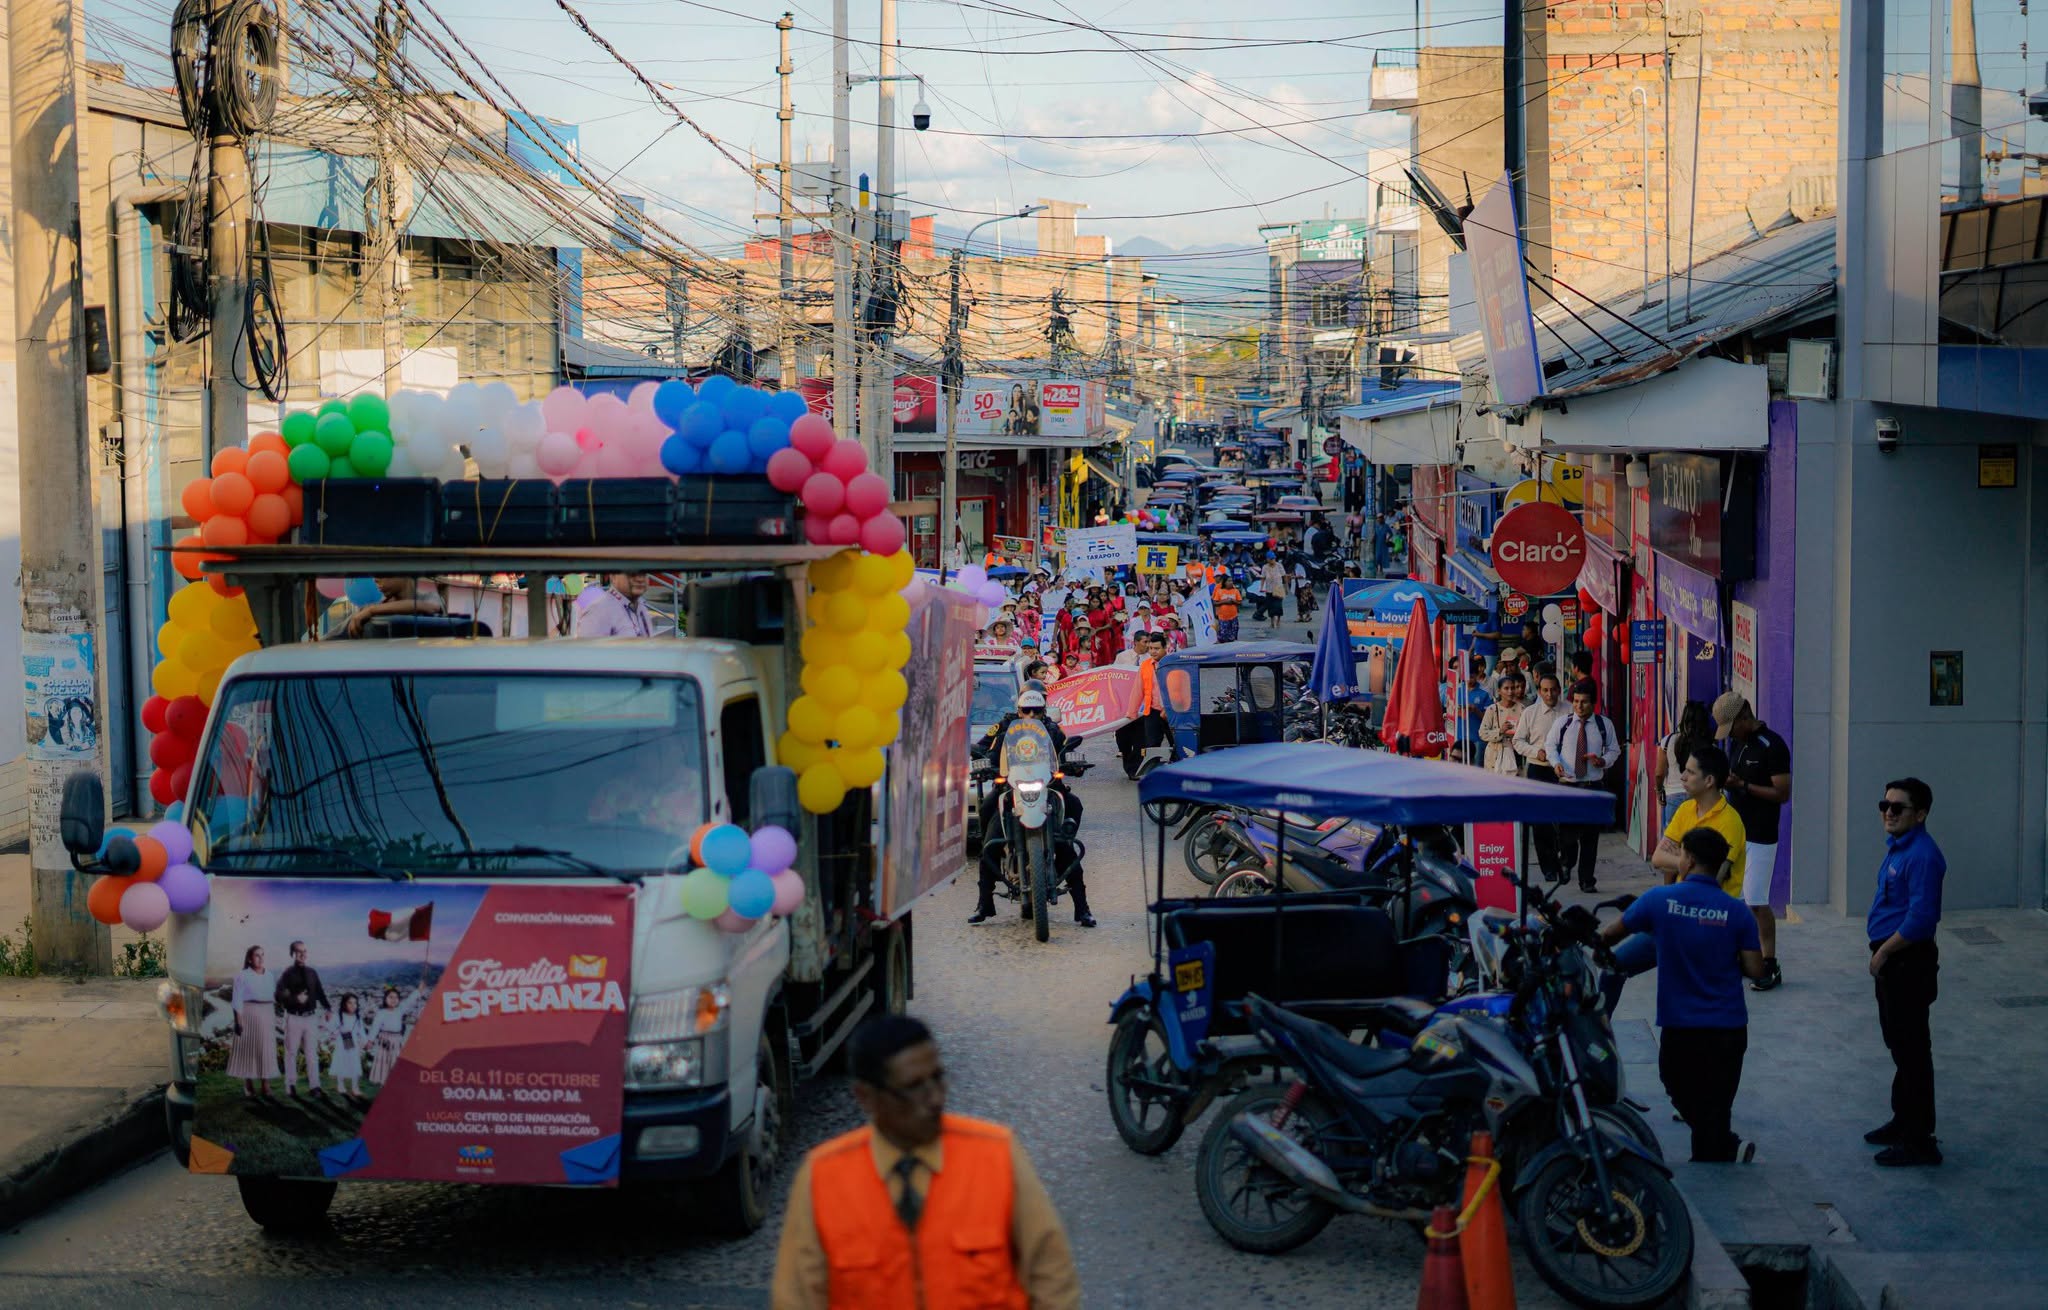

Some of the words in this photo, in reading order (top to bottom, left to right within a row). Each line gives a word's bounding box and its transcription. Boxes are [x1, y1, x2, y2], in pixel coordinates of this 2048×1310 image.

[1086, 552, 1121, 561] TARAPOTO
[1479, 843, 1505, 855] Enjoy
[1479, 855, 1510, 865] better
[1479, 867, 1495, 877] life
[457, 957, 568, 991] Familia
[441, 981, 626, 1023] ESPERANZA
[419, 1070, 448, 1084] DEL
[450, 1068, 464, 1085] 8
[466, 1071, 485, 1085] AL
[488, 1069, 501, 1084] 11
[504, 1073, 524, 1085] DE
[527, 1073, 601, 1088] OCTUBRE
[442, 1087, 475, 1100] 9:00
[463, 1112, 507, 1122] CENTRO
[509, 1113, 524, 1123] DE
[533, 1125, 548, 1136] DE
